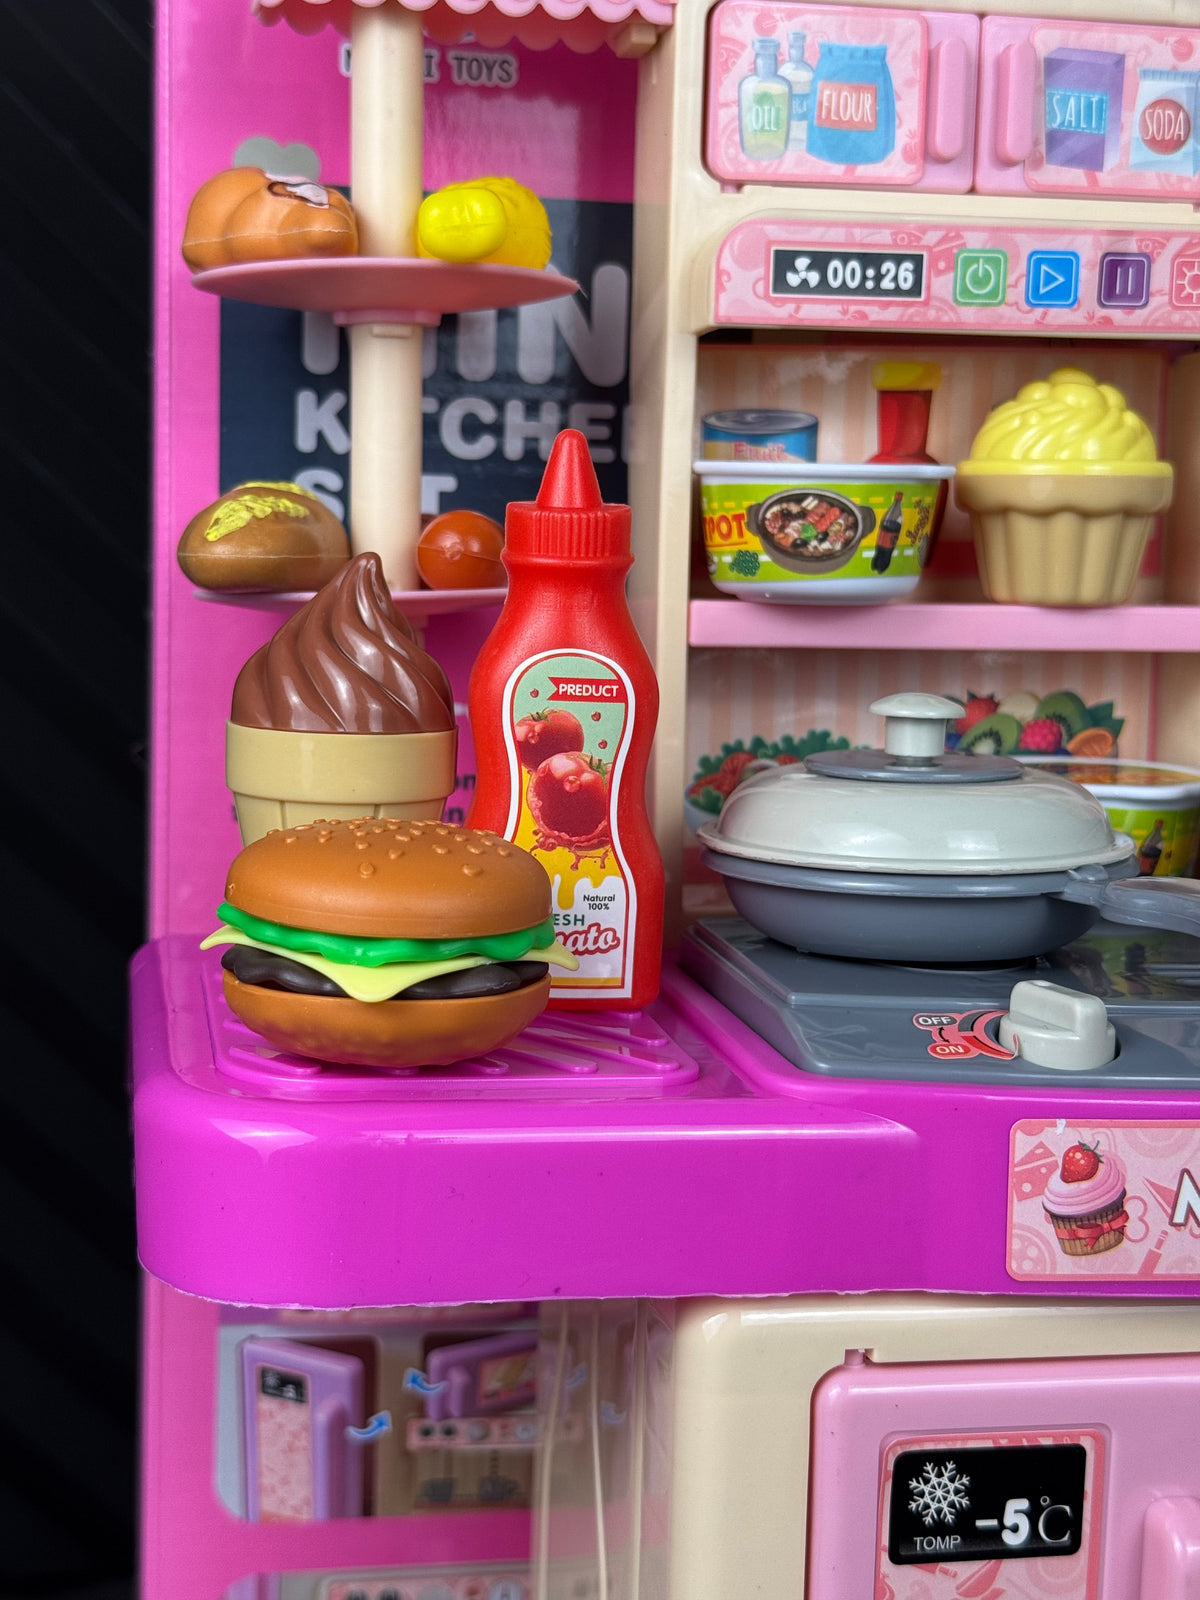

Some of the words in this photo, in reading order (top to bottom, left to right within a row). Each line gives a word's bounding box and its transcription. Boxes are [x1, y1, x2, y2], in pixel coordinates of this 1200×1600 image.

[452, 56, 513, 84] TOYS
[821, 89, 873, 123] FLOUR
[1051, 94, 1099, 129] SALT
[751, 105, 777, 131] OIL
[1143, 108, 1185, 141] SODA
[826, 259, 915, 291] 00:26
[558, 683, 619, 697] PREDUCT
[583, 894, 616, 902] Natural
[588, 902, 610, 911] 100%
[553, 913, 586, 926] ESH
[556, 922, 621, 956] ato
[918, 1016, 951, 1025] OFF
[935, 1045, 965, 1054] ON
[913, 1535, 962, 1551] TOMP
